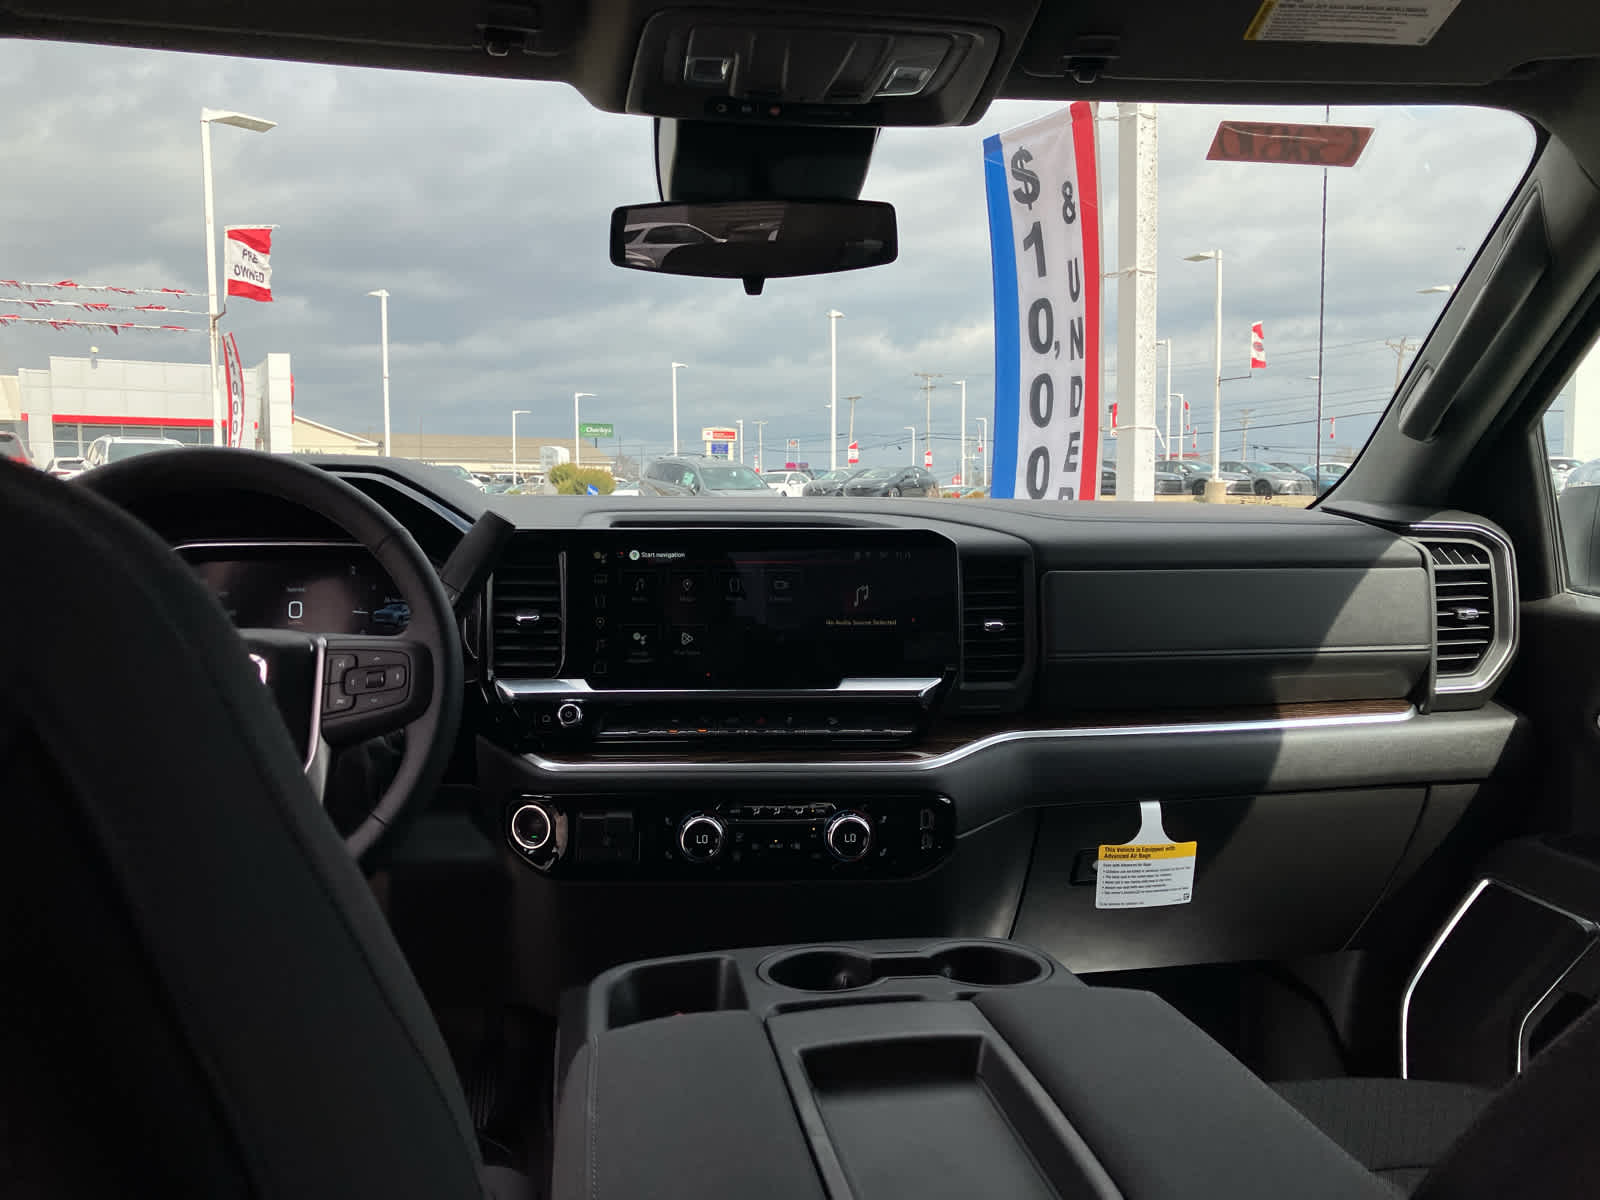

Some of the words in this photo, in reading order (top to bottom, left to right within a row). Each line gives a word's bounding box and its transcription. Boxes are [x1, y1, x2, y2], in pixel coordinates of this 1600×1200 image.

[1061, 181, 1077, 225] &
[242, 249, 258, 264] PRE
[233, 264, 265, 283] OWNED
[641, 551, 657, 559] Start
[657, 551, 686, 560] navigation
